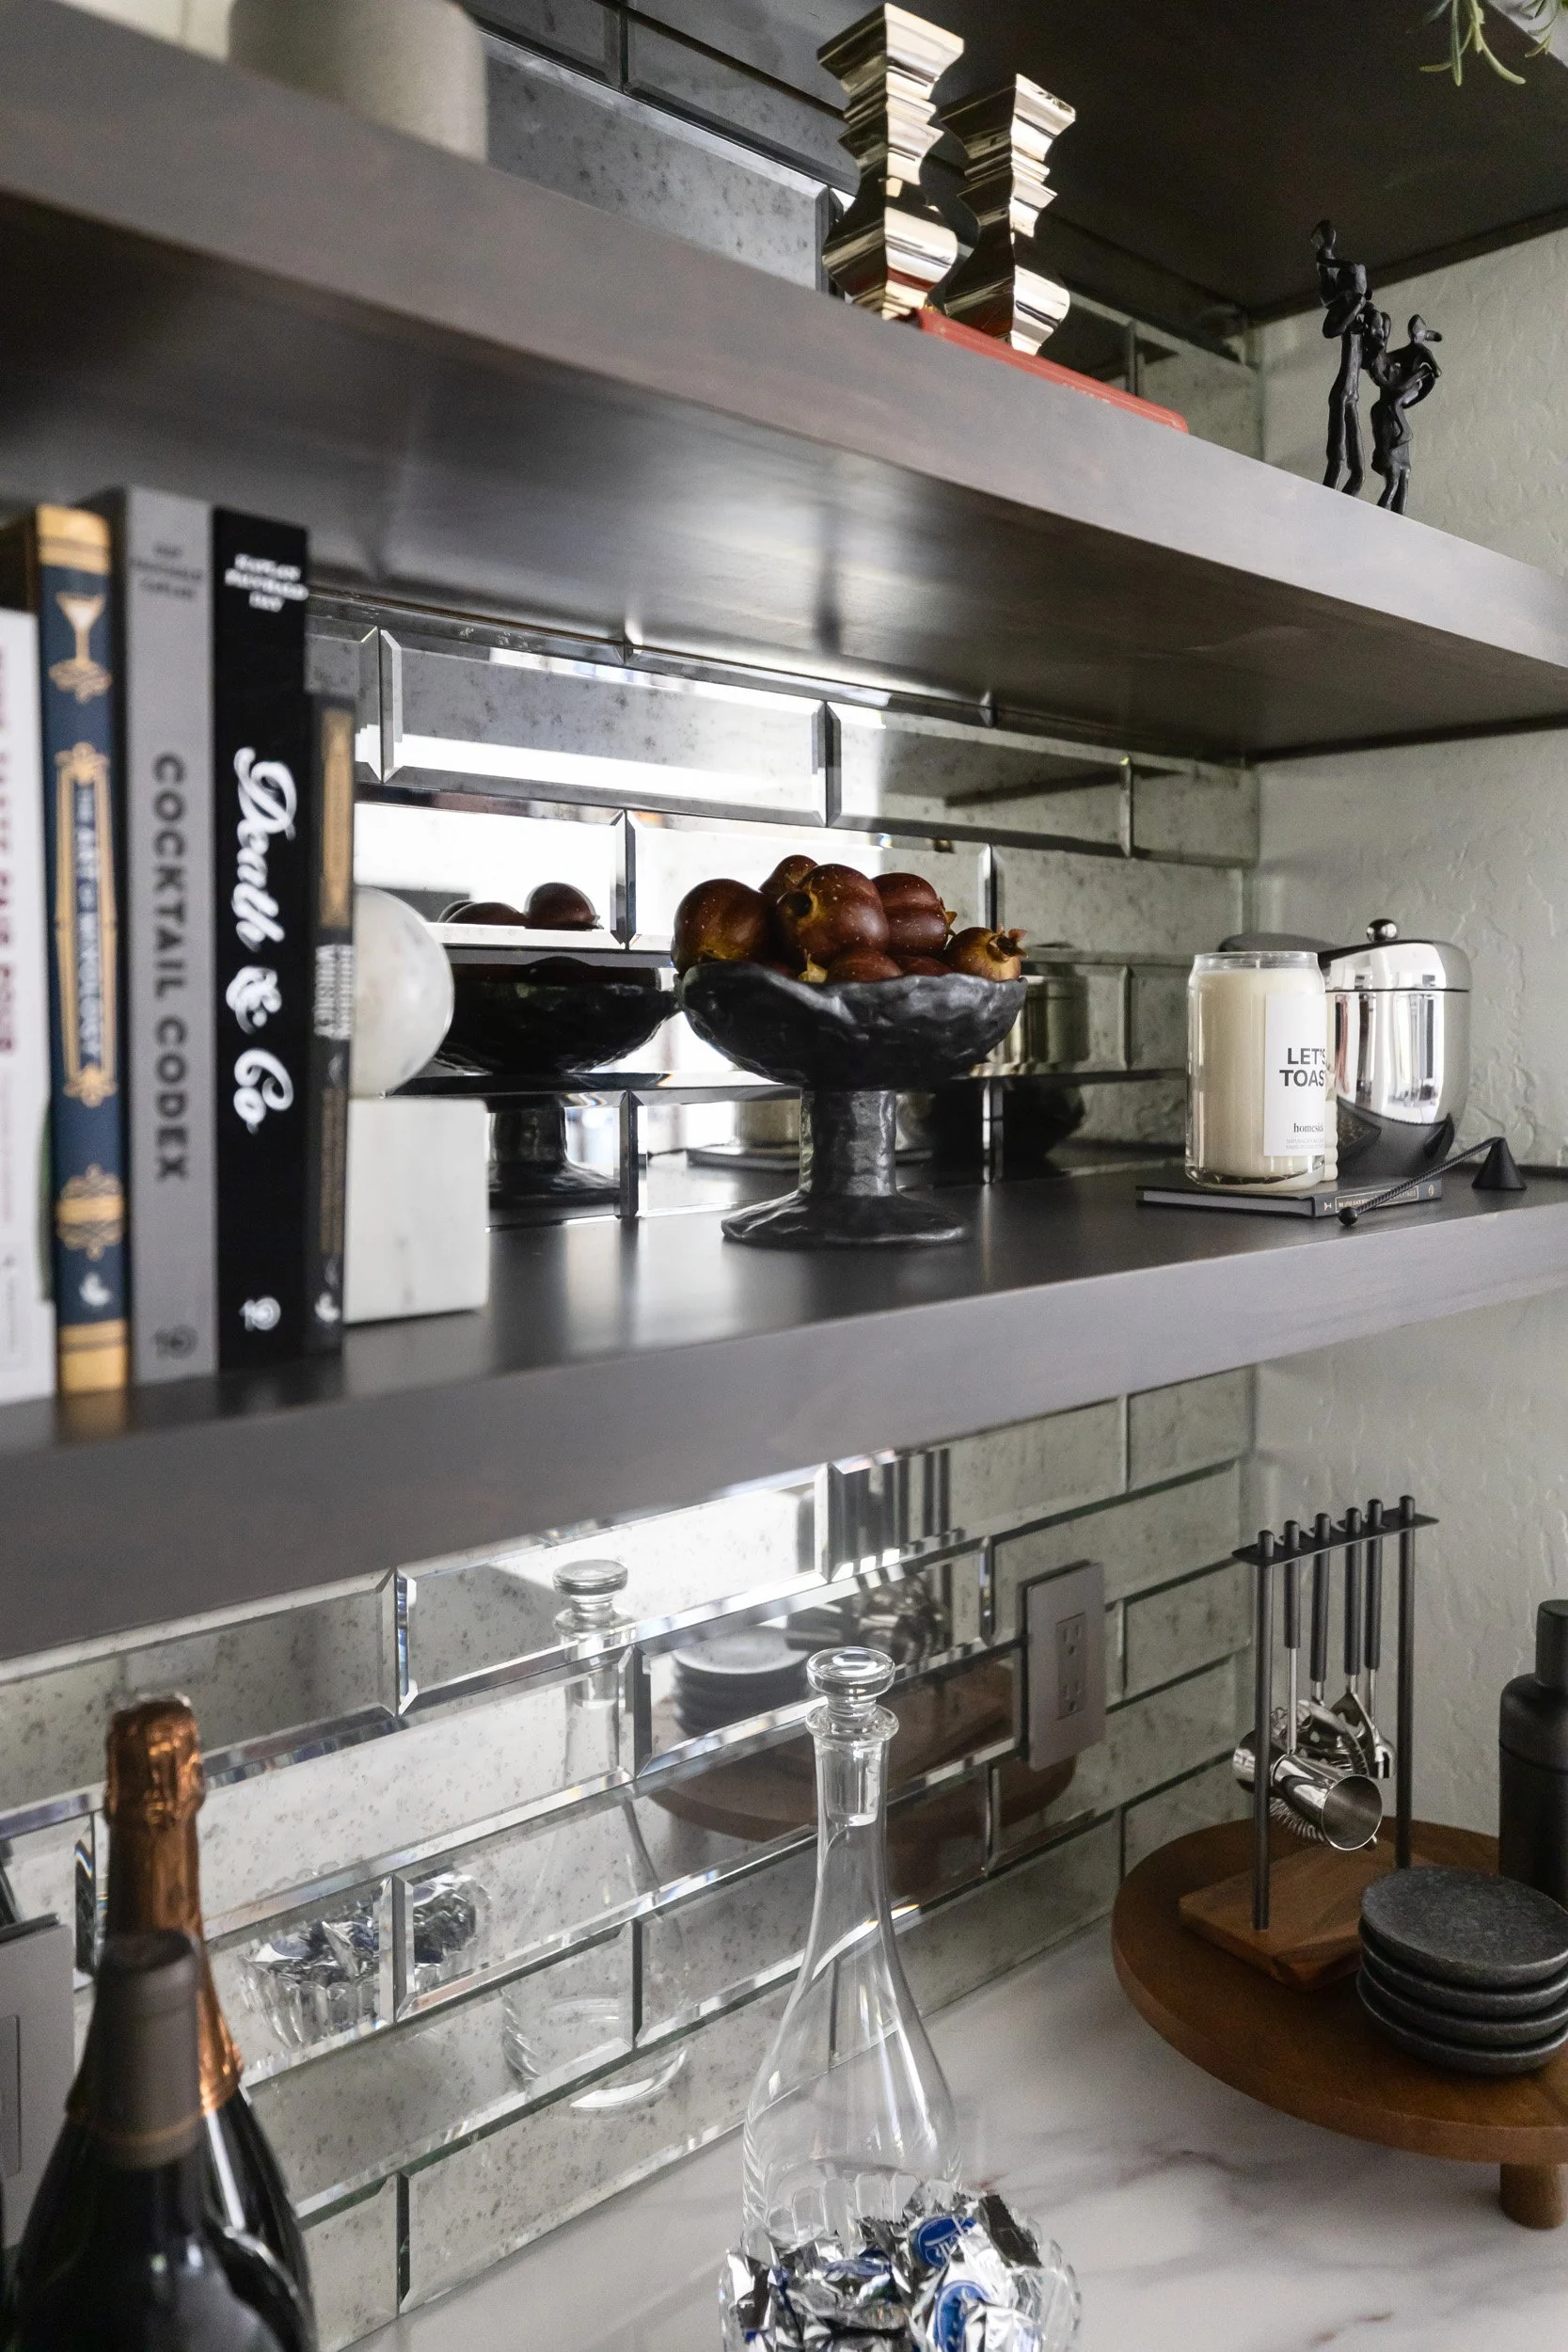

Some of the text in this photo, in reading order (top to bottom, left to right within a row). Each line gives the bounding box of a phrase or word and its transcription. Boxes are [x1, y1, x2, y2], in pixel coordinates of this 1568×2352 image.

[152, 752, 187, 1183] COCKTAIL CODEX
[226, 746, 297, 1135] Death & Co
[1278, 1069, 1326, 1088] TOAS
[1287, 1047, 1326, 1065] LET'S
